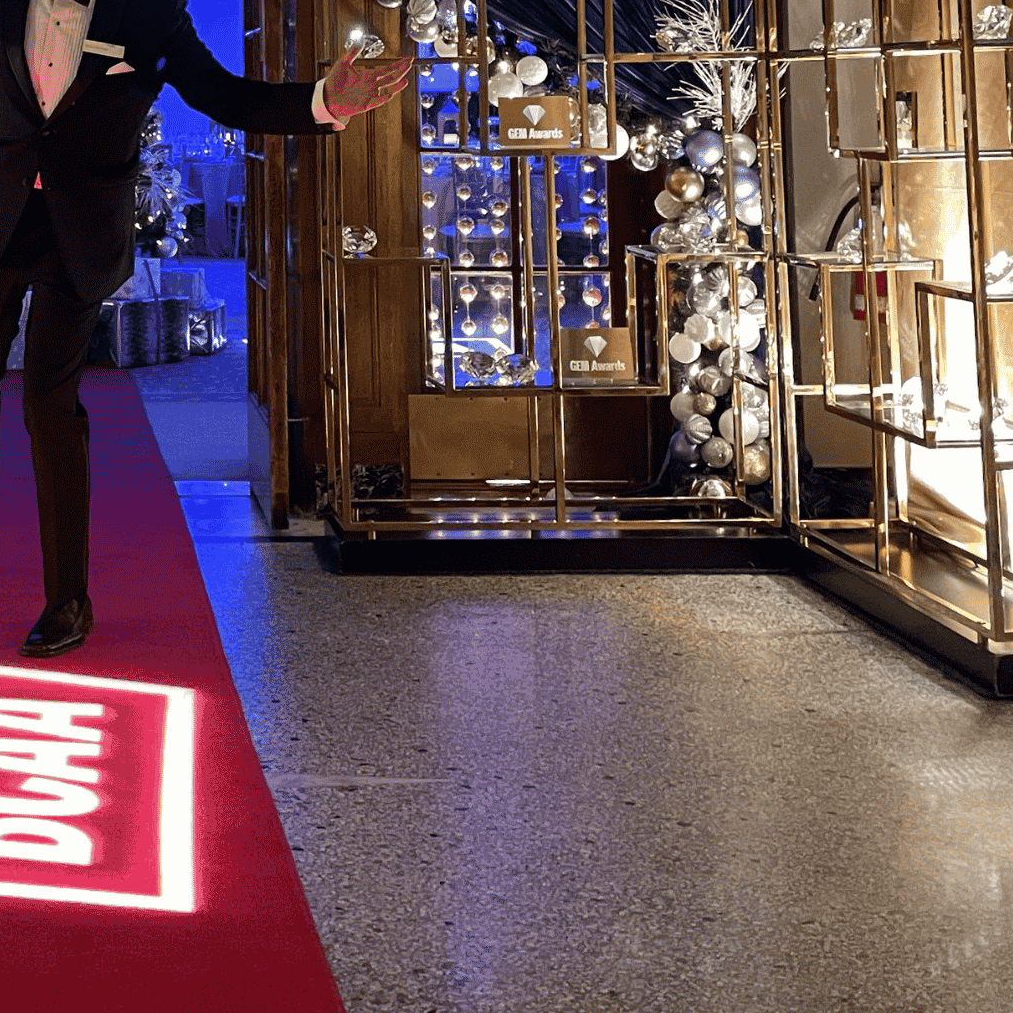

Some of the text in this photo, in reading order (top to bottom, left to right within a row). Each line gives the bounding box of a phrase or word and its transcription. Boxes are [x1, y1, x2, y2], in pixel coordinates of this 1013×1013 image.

[508, 128, 564, 139] GEM Awards
[570, 360, 626, 371] GEM Awards
